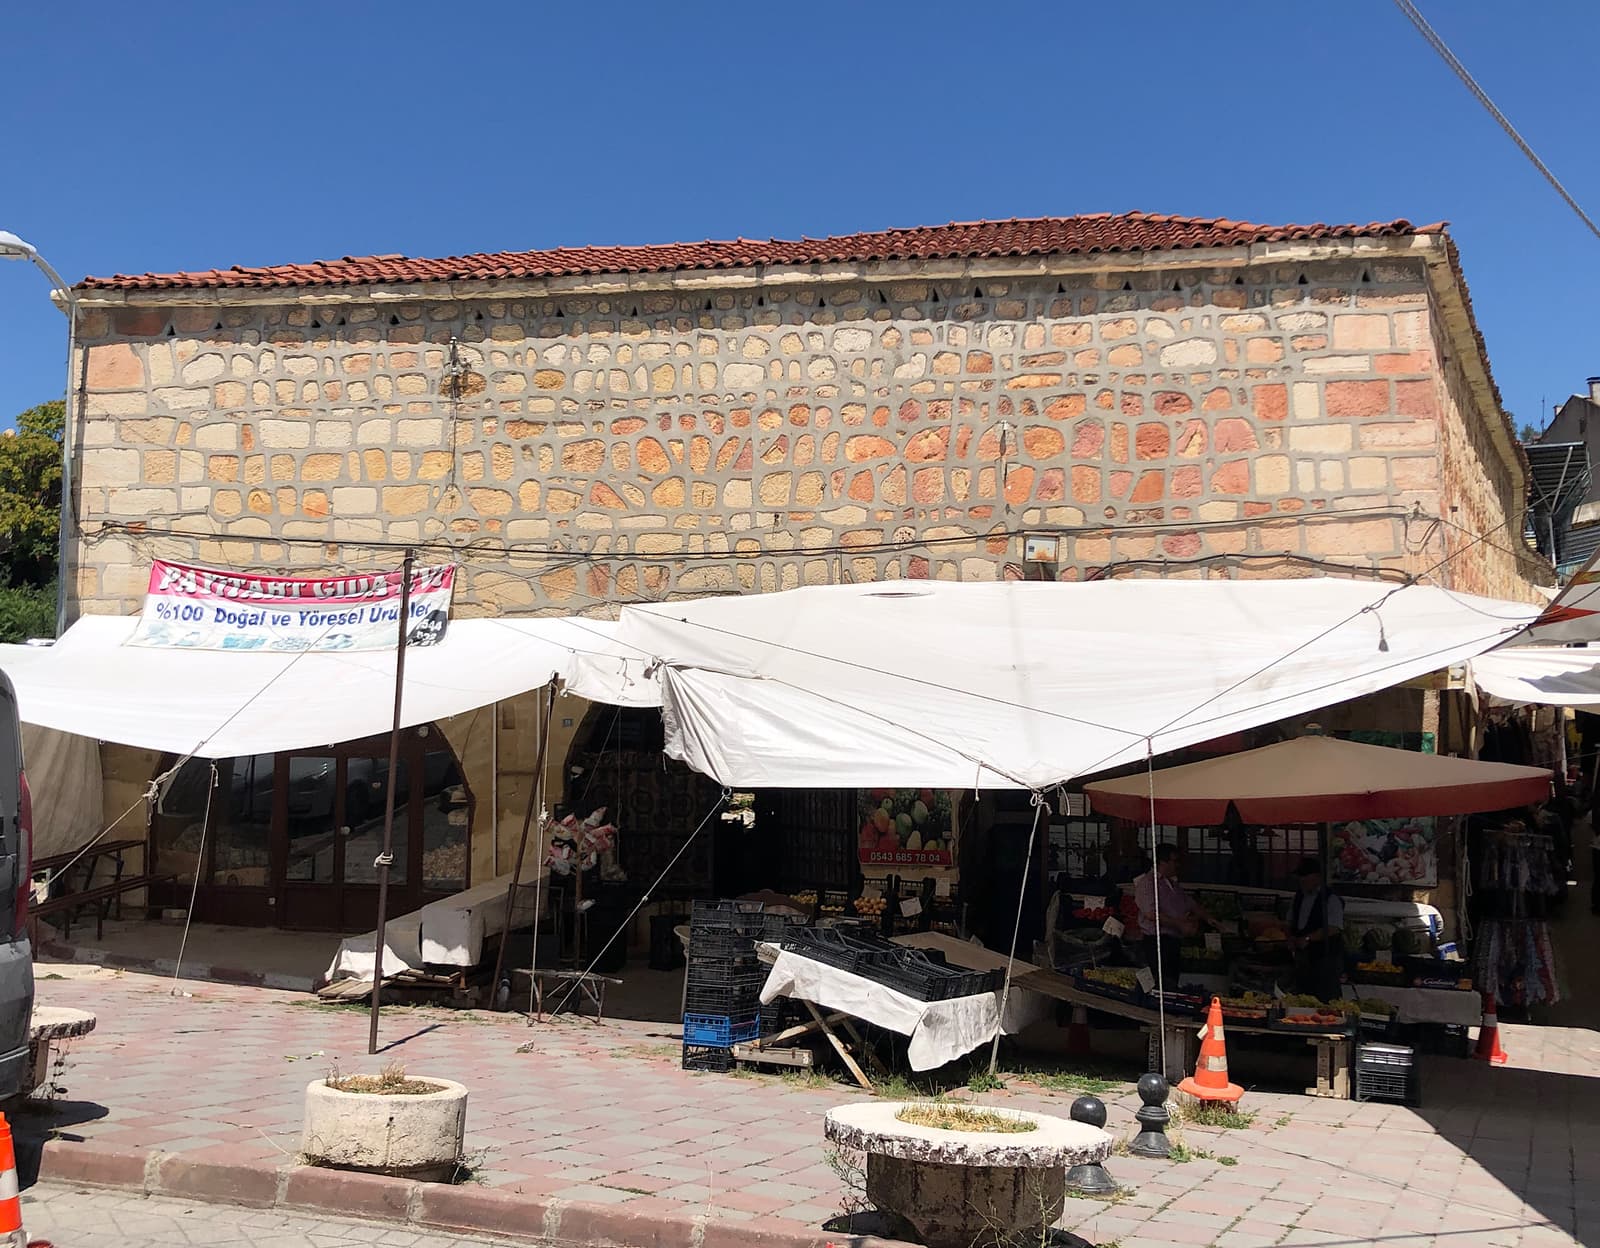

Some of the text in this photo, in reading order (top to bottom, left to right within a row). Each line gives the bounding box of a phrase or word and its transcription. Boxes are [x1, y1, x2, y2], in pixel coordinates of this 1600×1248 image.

[313, 575, 388, 600] GIDA
[156, 602, 432, 628] %100 Doğal ve Yöresel Ürüler
[870, 851, 893, 861] 0543
[896, 853, 912, 862] 685
